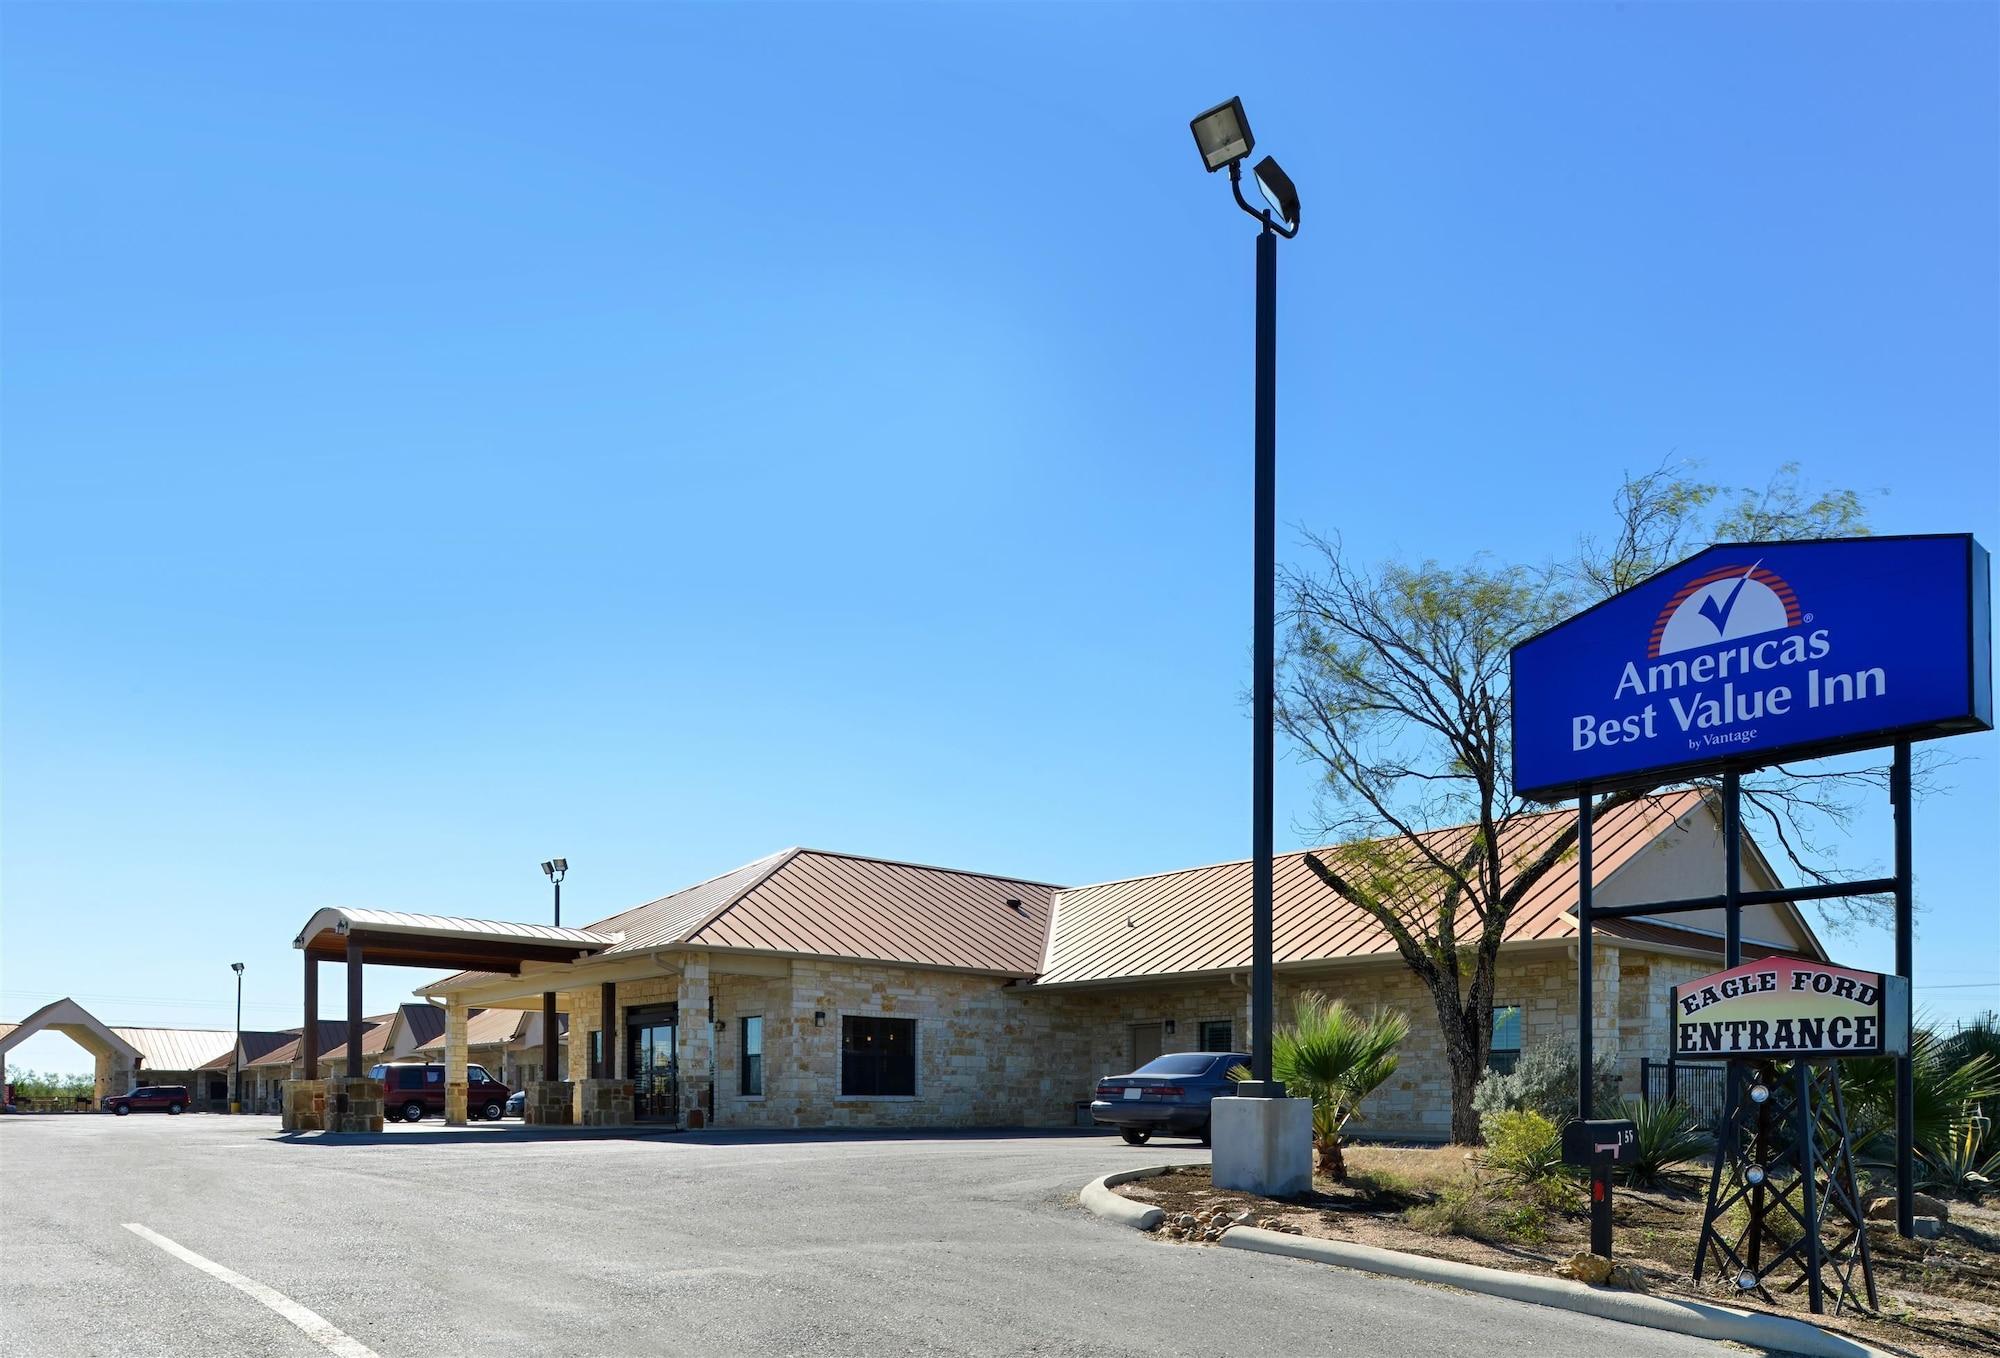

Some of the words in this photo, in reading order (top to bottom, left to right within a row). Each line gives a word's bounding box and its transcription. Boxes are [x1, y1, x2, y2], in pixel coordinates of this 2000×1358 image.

[1614, 628, 1831, 700] Americas
[1572, 703, 1658, 752] Best
[1669, 682, 1792, 732] Value
[1808, 666, 1886, 709] Inn
[1688, 737, 1702, 750] by
[1703, 727, 1758, 746] Vantage
[1679, 972, 1777, 1016] EAGLE
[1791, 971, 1879, 1007] FORD
[1679, 1015, 1877, 1051] ENTRANCE
